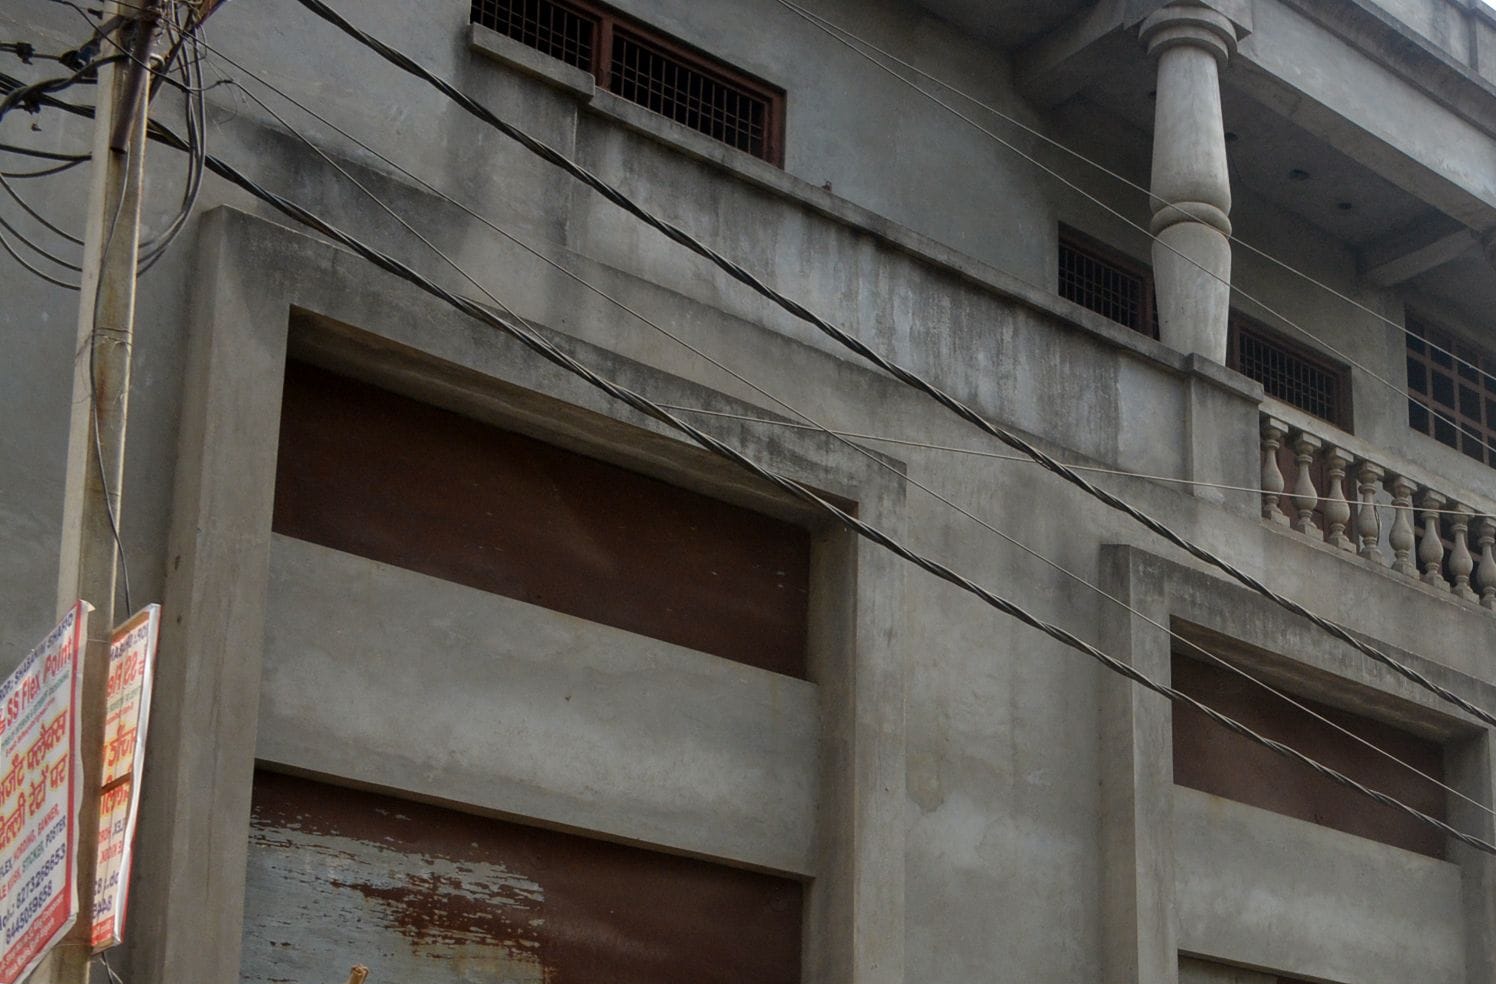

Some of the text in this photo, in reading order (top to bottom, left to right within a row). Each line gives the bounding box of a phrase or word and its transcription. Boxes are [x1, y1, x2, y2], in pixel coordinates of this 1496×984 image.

[7, 637, 73, 727] SS Flex Point
[50, 754, 68, 789] पर
